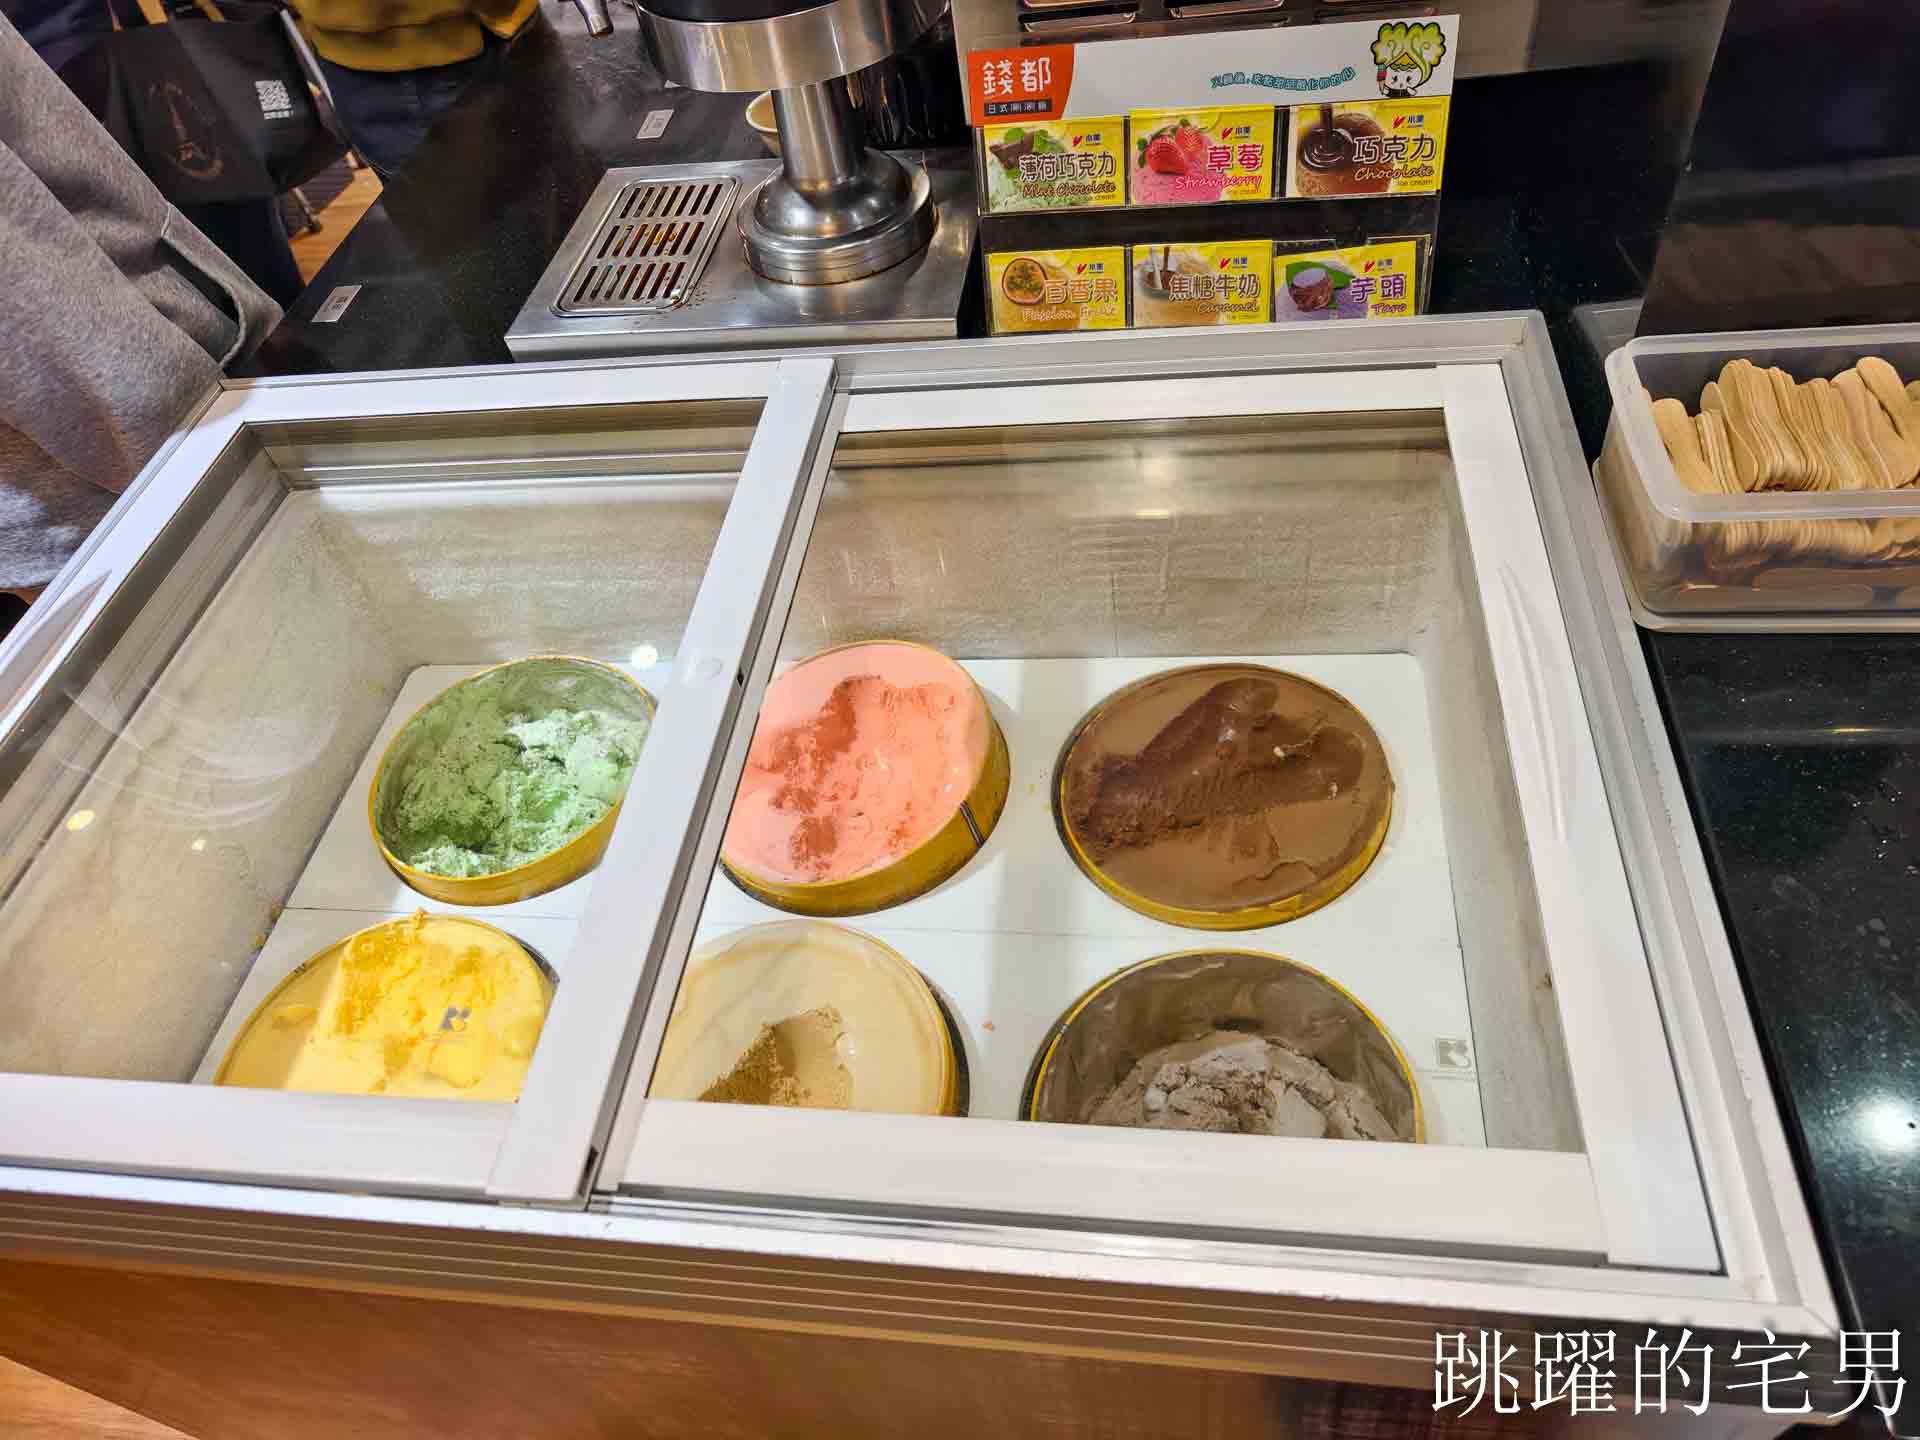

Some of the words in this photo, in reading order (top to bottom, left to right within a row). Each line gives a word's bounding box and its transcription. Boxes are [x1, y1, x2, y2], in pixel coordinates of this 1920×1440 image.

[982, 57, 1052, 96] 錢都
[1207, 144, 1264, 174] 草莓
[1352, 133, 1437, 164] 巧克力
[1019, 150, 1117, 183] 薄荷巧克力
[1354, 163, 1434, 181] Chocolate
[1056, 180, 1117, 197] Chocolate
[1175, 175, 1263, 192] Strawberry
[1045, 278, 1120, 305] 百香果
[1168, 273, 1261, 301] 焦糖牛奶
[1351, 273, 1407, 303] 芋頭
[1197, 300, 1260, 313] Caramel
[1371, 302, 1408, 315] Taro
